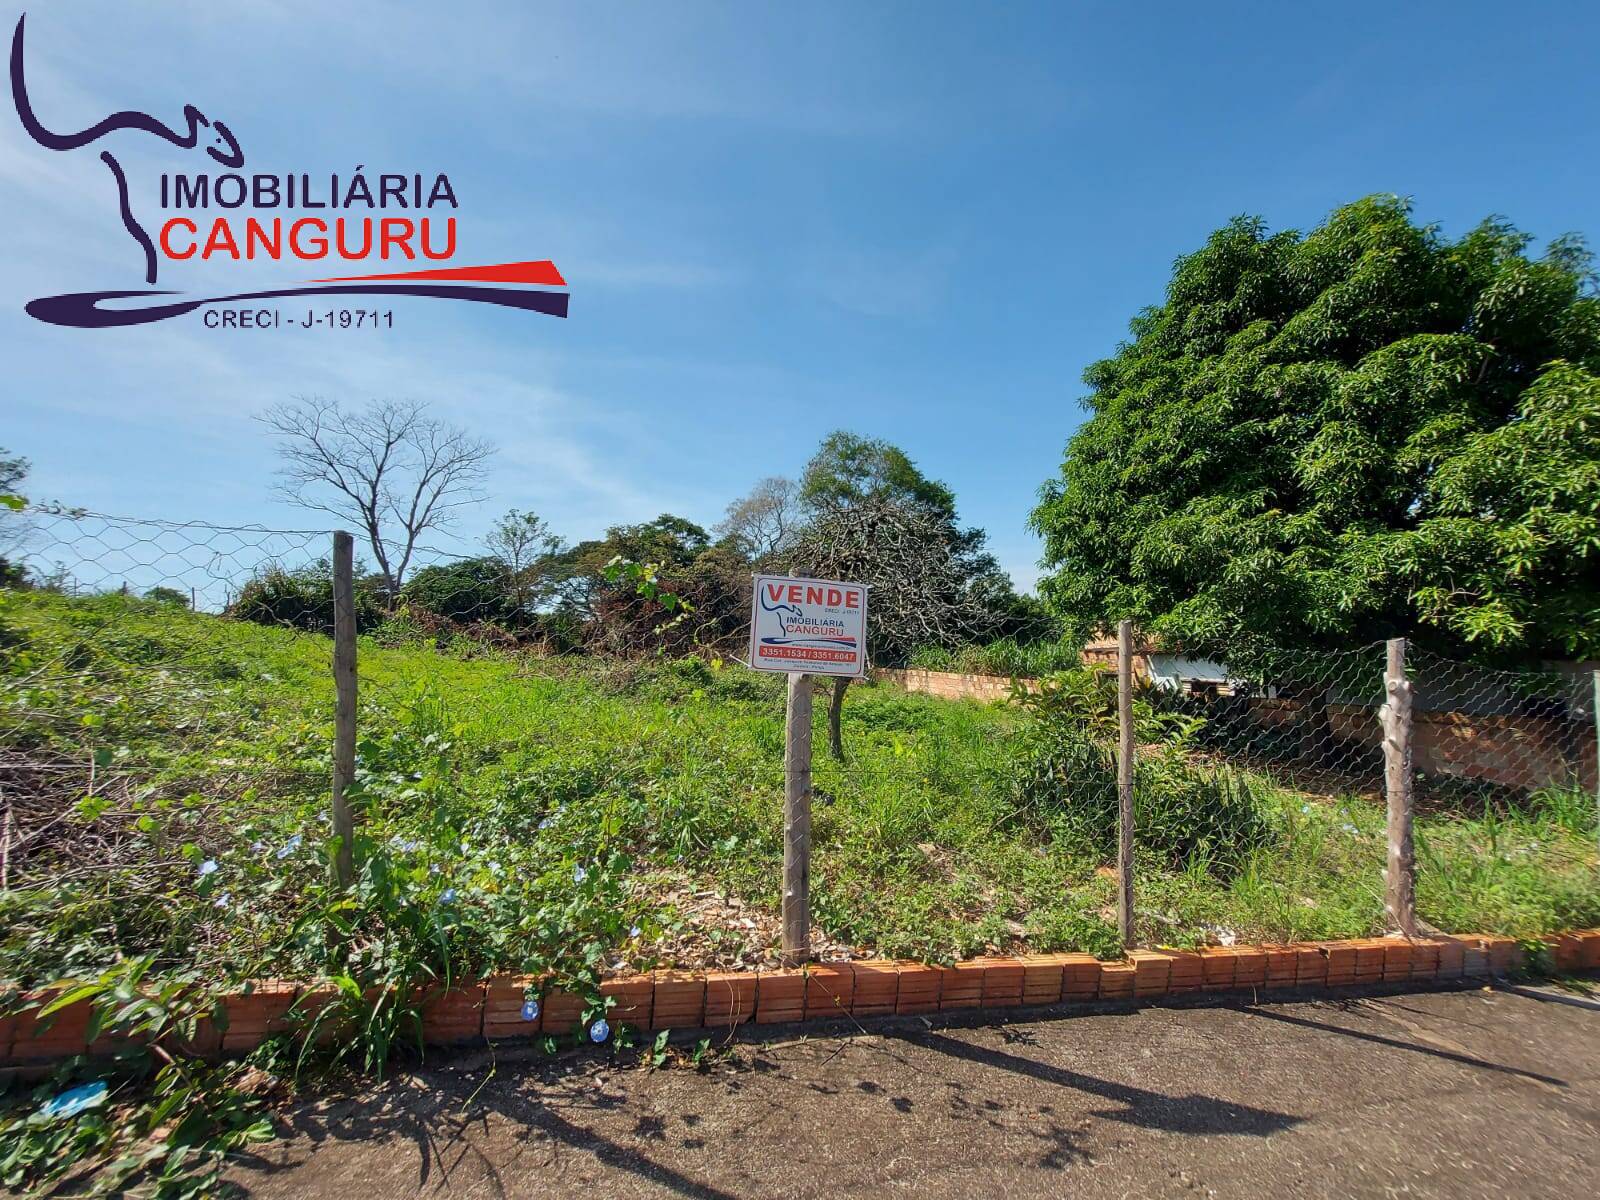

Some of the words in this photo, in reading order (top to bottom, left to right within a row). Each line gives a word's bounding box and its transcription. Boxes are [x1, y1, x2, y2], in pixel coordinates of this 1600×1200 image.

[767, 584, 859, 608] VENDE
[786, 625, 844, 636] CANGURU
[762, 647, 807, 658] 3351.1534
